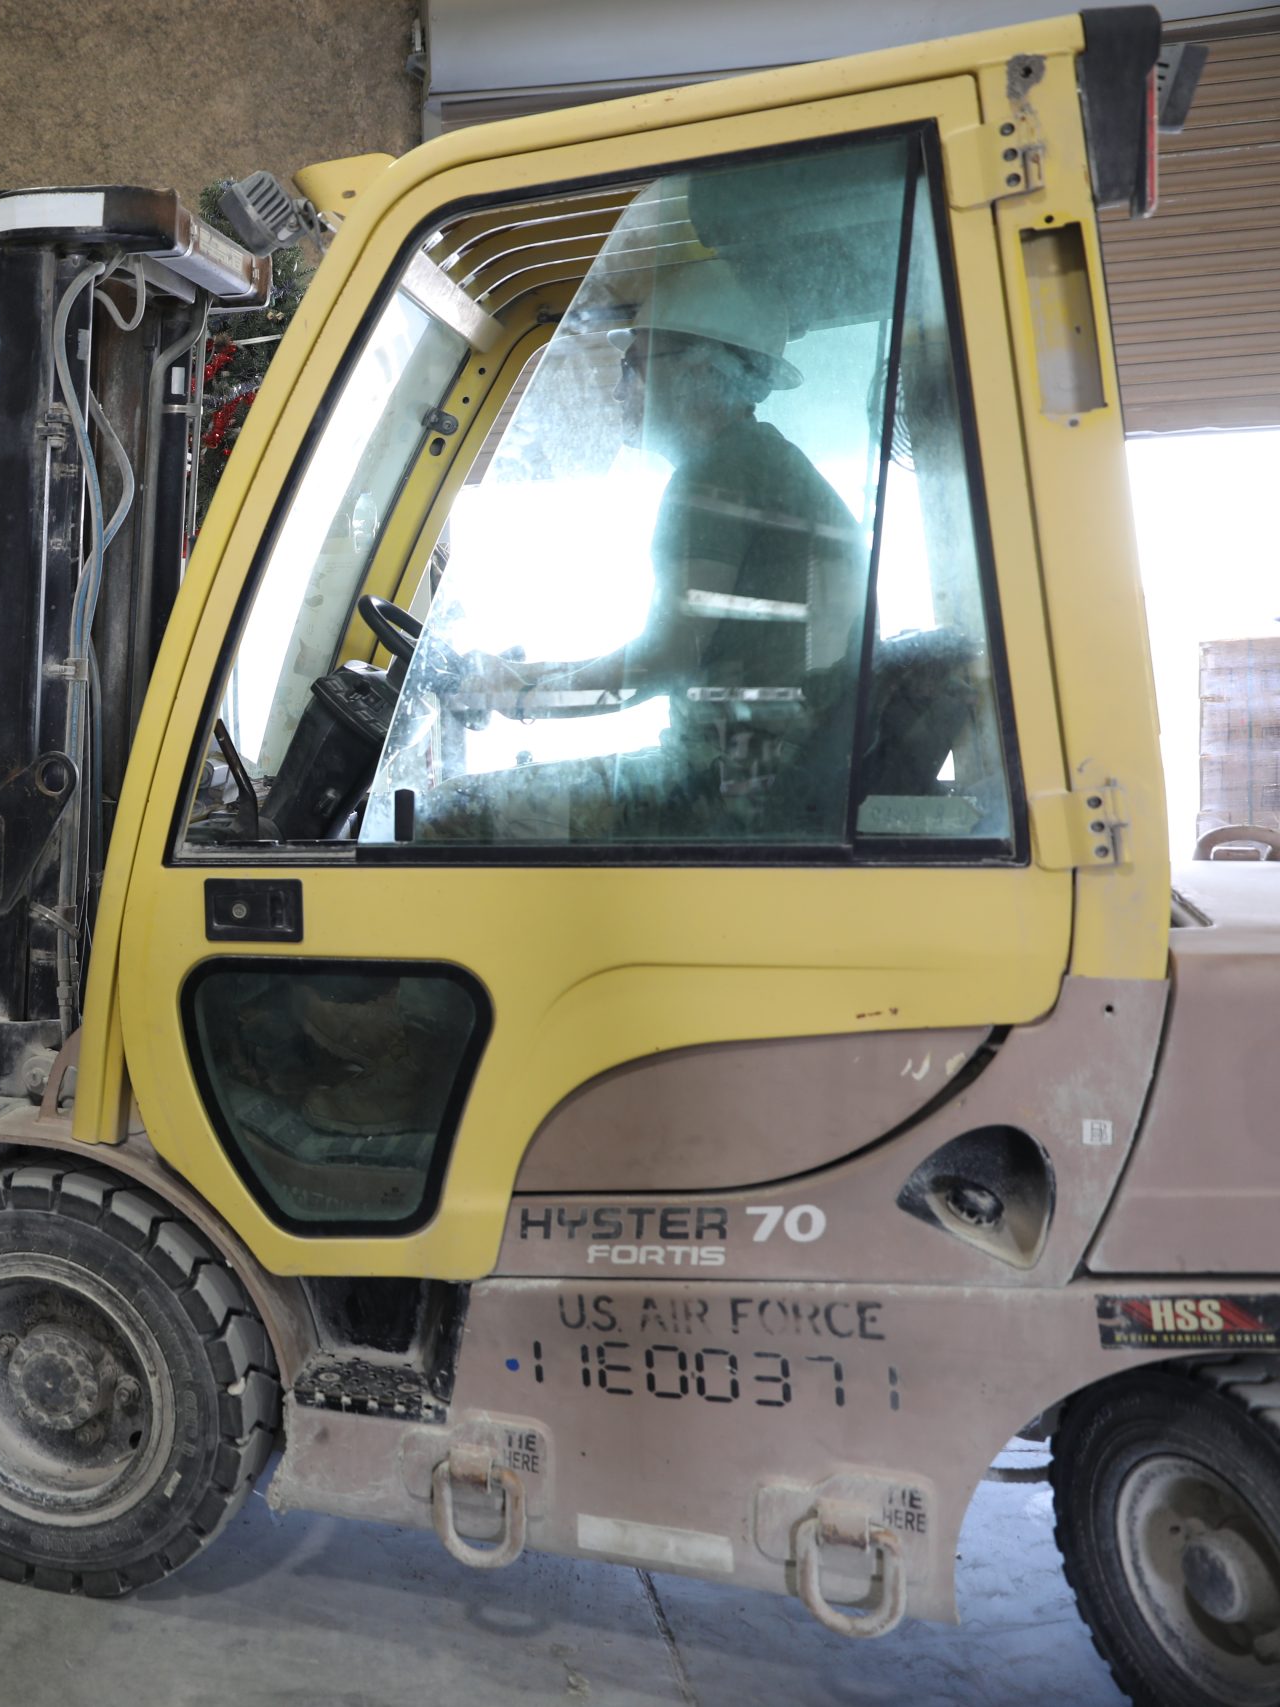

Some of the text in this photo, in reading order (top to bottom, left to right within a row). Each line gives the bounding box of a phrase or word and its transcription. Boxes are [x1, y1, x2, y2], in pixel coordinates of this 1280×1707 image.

[520, 1204, 827, 1243] HYSTER 70
[586, 1244, 726, 1267] FORTIS
[640, 1297, 710, 1335] AIR
[731, 1298, 886, 1340] FORCE
[1150, 1299, 1225, 1332] HSS
[505, 1430, 537, 1452] TIE
[504, 1451, 540, 1474] HERE
[882, 1508, 927, 1534] HERE
